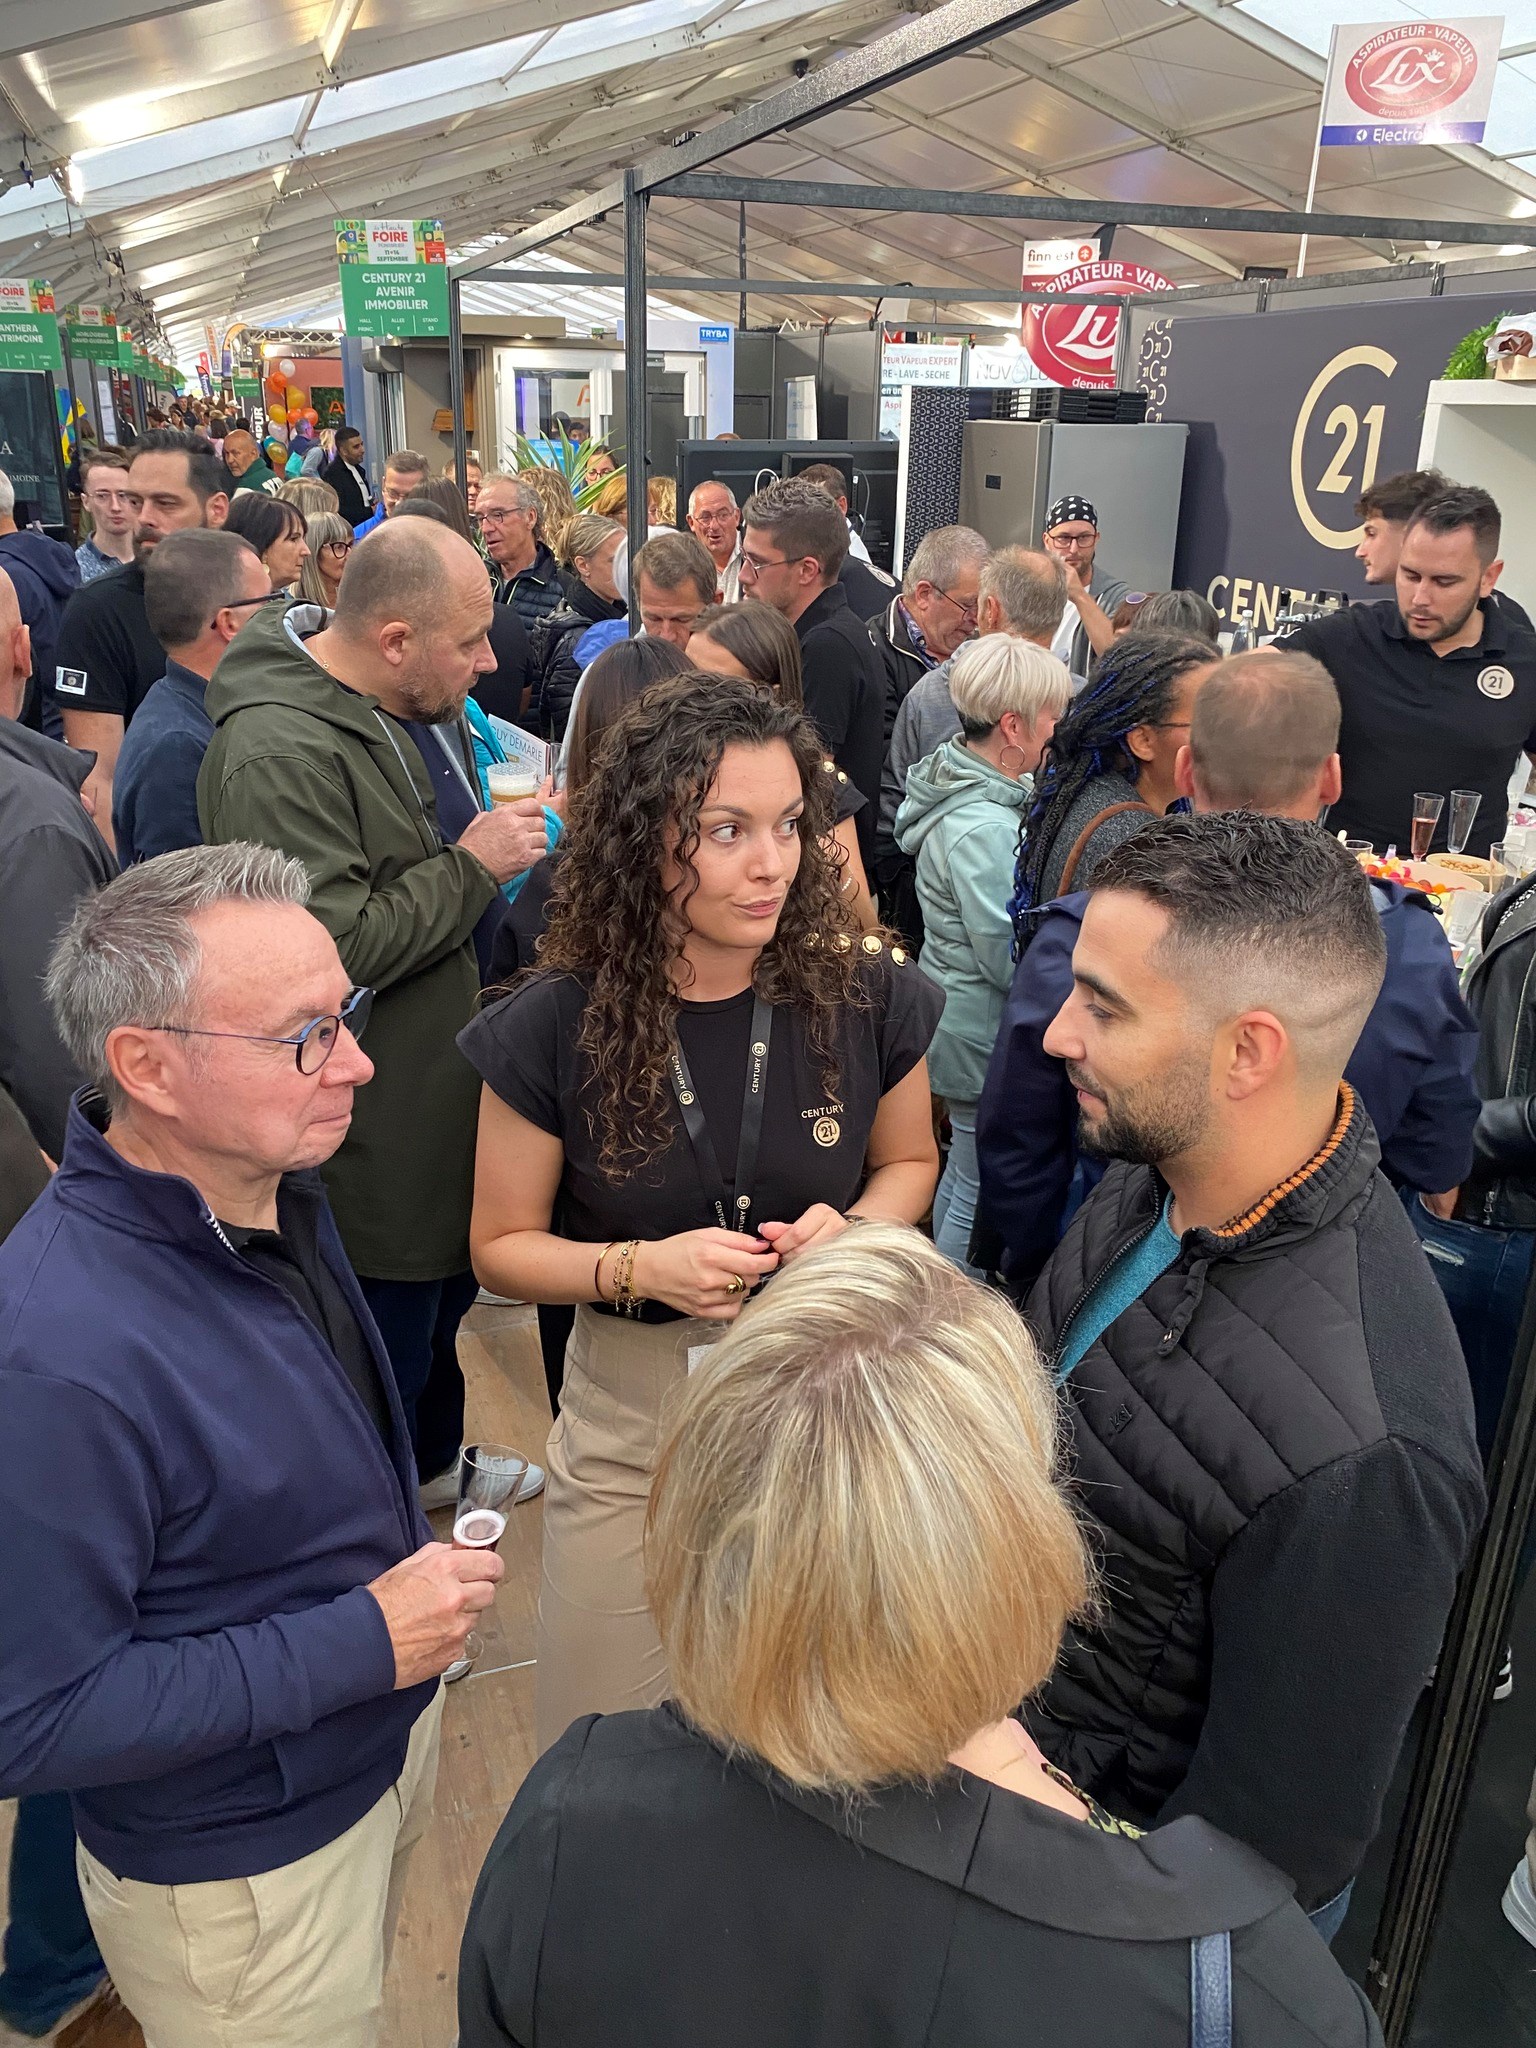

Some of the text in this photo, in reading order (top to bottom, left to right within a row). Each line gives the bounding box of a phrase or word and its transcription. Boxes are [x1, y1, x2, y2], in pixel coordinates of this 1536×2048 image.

[1352, 25, 1425, 69] ASPIRATEUR
[1434, 26, 1473, 65] VAPEUR
[1378, 106, 1407, 117] depuis
[372, 231, 408, 243] FOIRE
[362, 273, 426, 283] CENTURY 21
[0, 287, 25, 296] OIRE
[376, 286, 416, 297] AVENIR
[1031, 263, 1123, 320] APIRATEUR
[364, 299, 429, 310] IMMOBILIER
[700, 329, 728, 338] TRYBA
[928, 356, 958, 366] EXPERT
[899, 369, 919, 379] LAVE
[925, 370, 950, 380] SECHE
[1316, 404, 1386, 494] 21
[509, 734, 543, 763] DEMARLE
[671, 1055, 687, 1090] CENTURY
[751, 1057, 762, 1094] CENTURY
[801, 1103, 844, 1119] CENTURY
[714, 1200, 728, 1230] CENTURY
